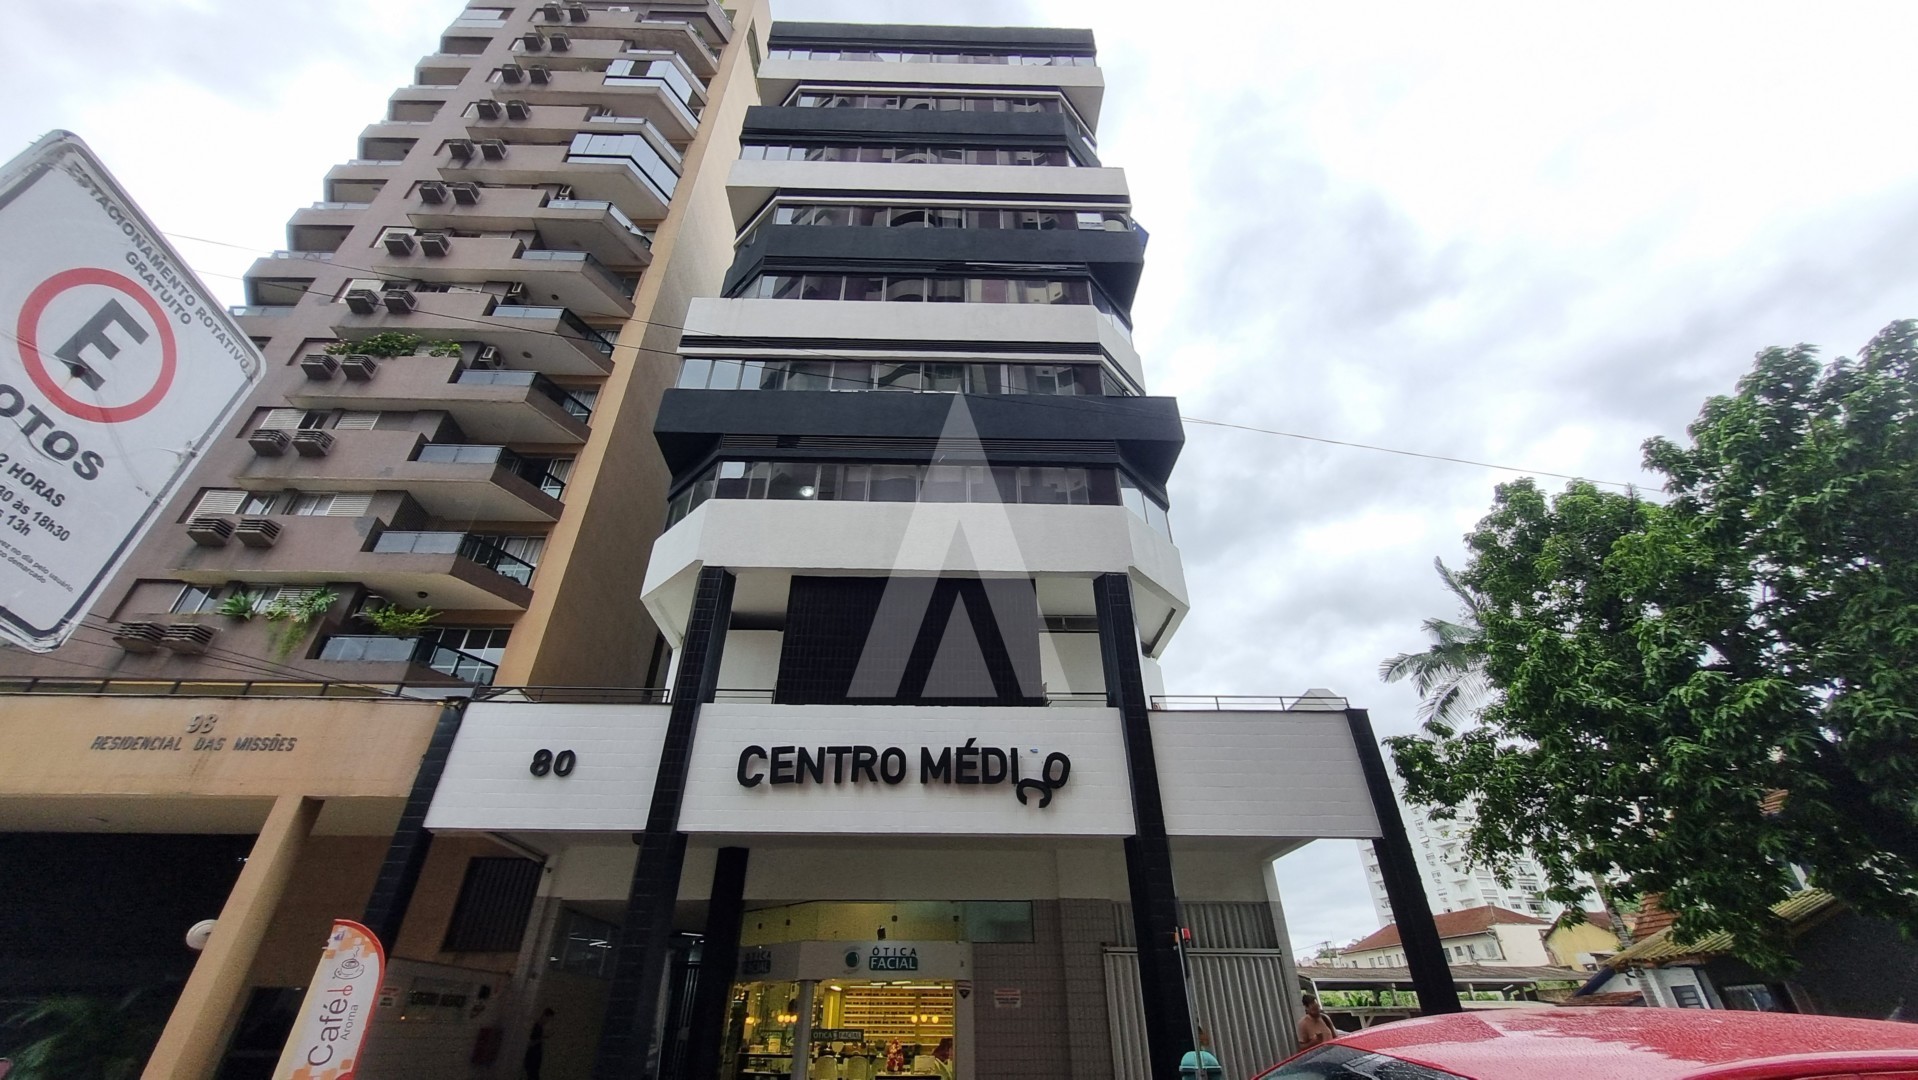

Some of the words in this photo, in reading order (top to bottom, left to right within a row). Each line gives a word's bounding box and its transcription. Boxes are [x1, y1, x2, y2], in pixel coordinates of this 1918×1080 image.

[67, 160, 196, 308] ESTACIONAMENTO
[194, 306, 251, 373] ROTATIVO
[125, 250, 193, 326] GRATUITO
[53, 297, 150, 392] E
[7, 462, 66, 507] HORAS
[6, 514, 31, 536] 13h
[32, 511, 71, 541] 18h30
[7, 556, 46, 583] demarcado
[90, 735, 183, 751] RESIDENCIAL
[193, 736, 227, 751] DAS
[232, 732, 298, 752] MISSÕES
[530, 748, 577, 777] 80
[737, 744, 907, 788] CENTRO
[870, 957, 917, 970] FACIAL
[872, 946, 917, 956] ÓTICA
[307, 998, 348, 1066] Café
[340, 1004, 359, 1041] Aroma
